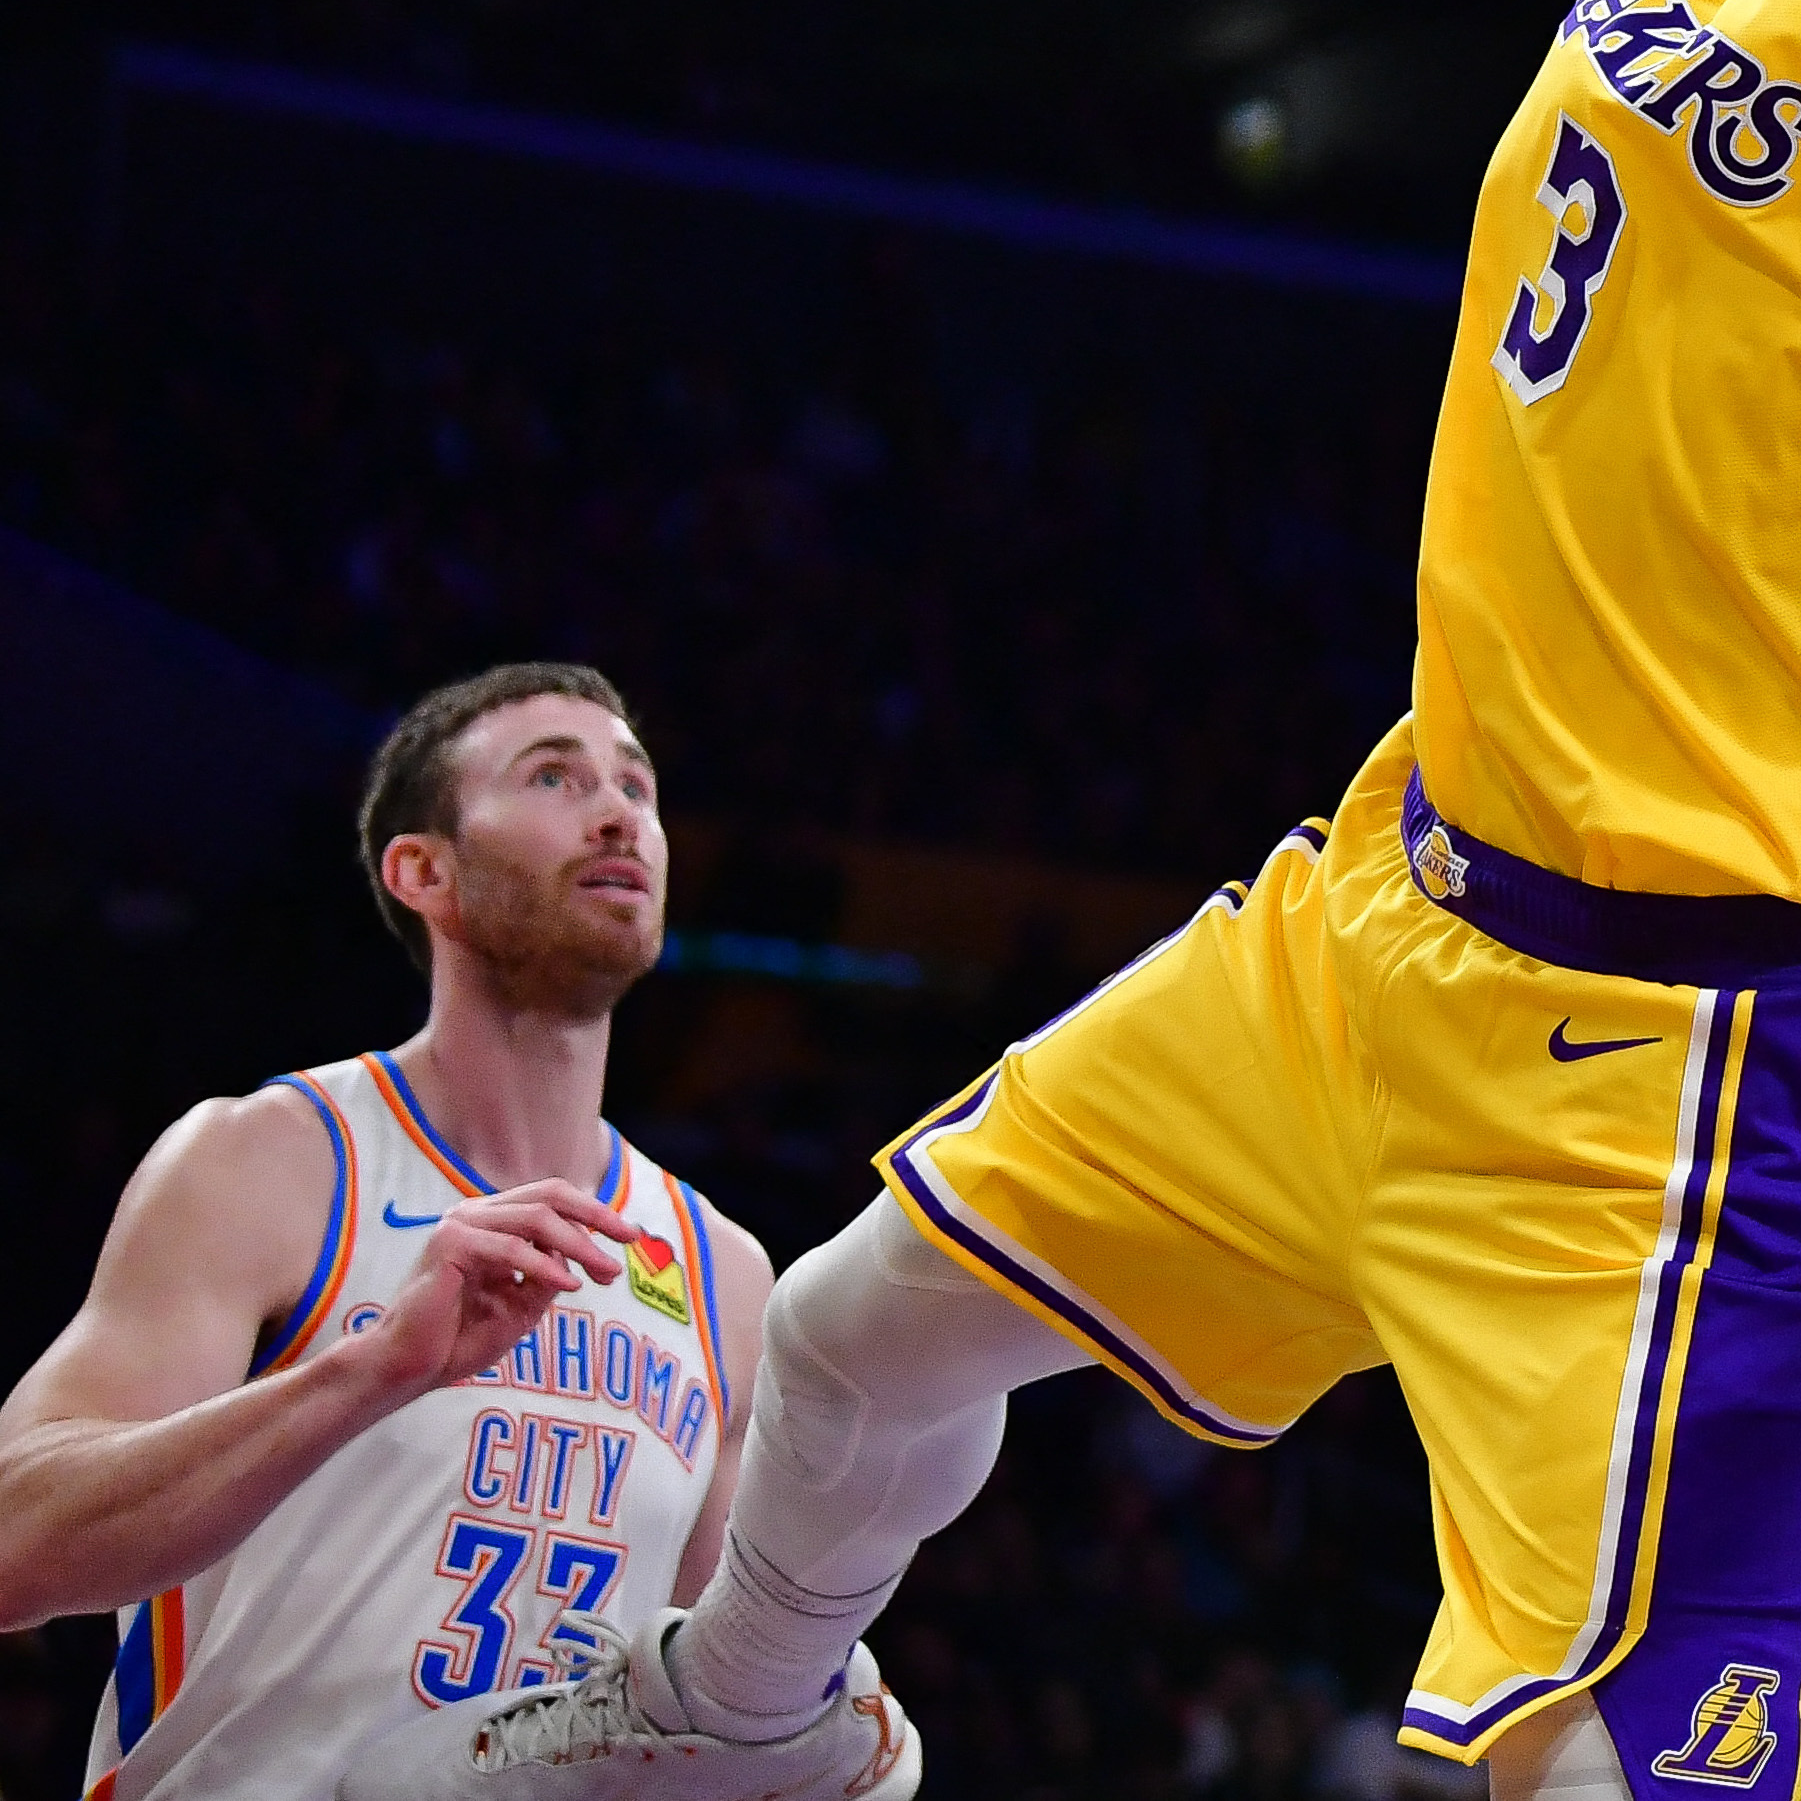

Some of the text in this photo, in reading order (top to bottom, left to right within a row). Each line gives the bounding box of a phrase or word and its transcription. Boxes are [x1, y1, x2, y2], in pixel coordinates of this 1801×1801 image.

[1490, 109, 1629, 406] 3
[463, 1406, 637, 1529] CITY
[410, 1511, 630, 1710] 33
